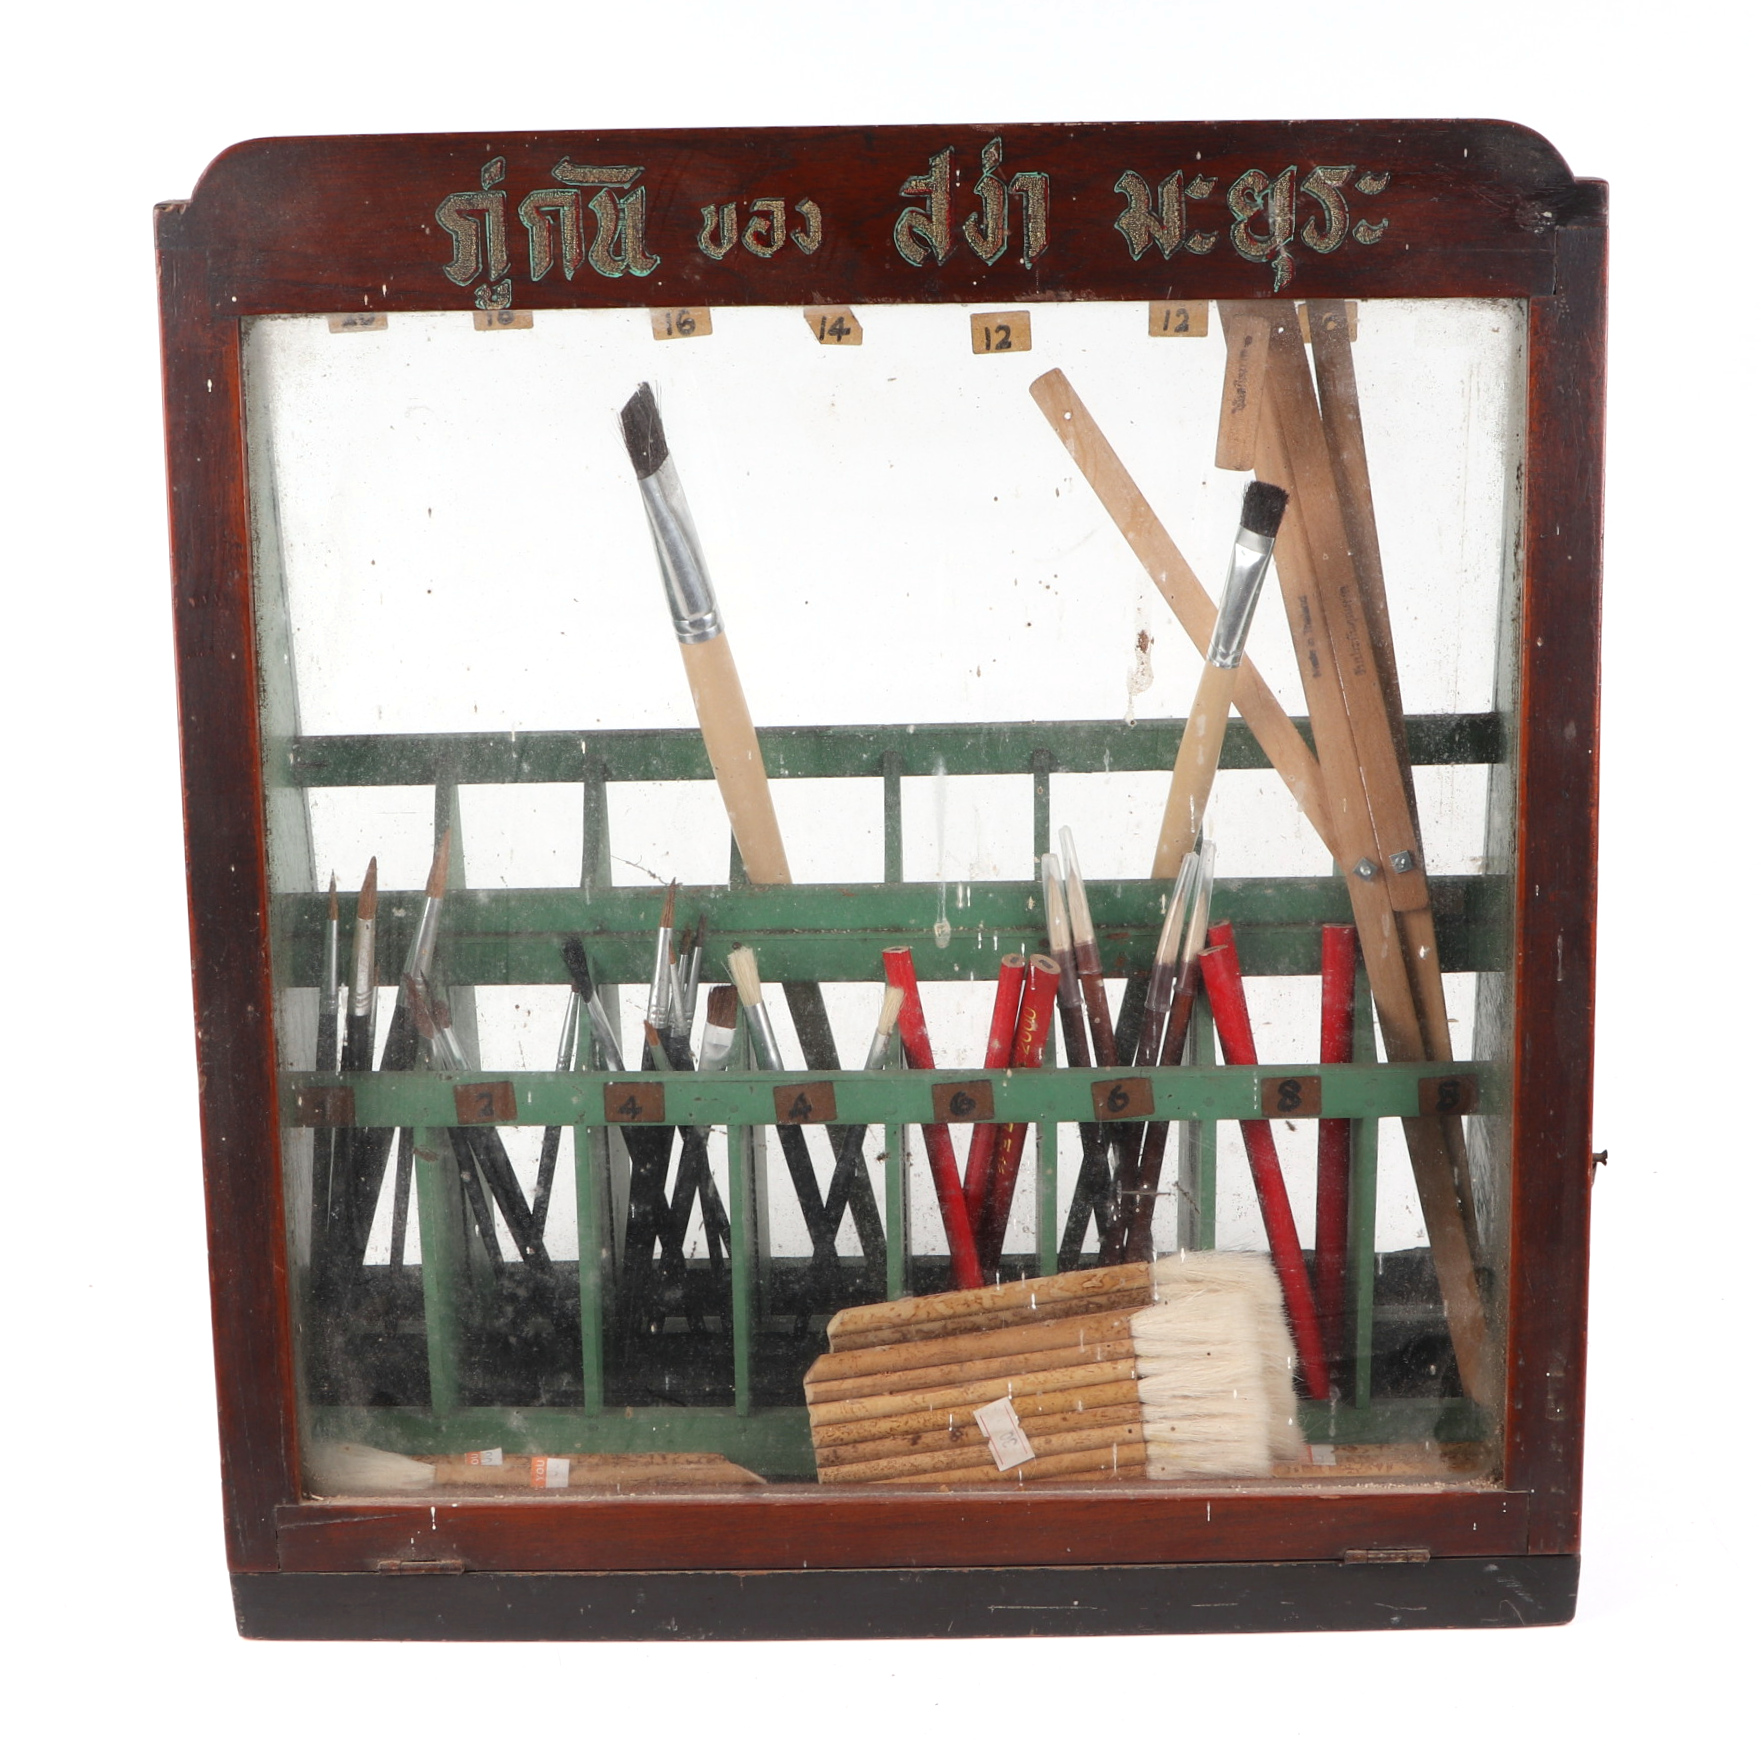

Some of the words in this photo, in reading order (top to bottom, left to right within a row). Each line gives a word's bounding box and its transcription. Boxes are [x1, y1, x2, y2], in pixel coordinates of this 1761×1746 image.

[698, 197, 823, 260] ของ
[893, 136, 1051, 270] สง่า
[665, 309, 696, 336] 16
[819, 316, 851, 342] 14
[1163, 308, 1189, 332] 12
[984, 325, 1012, 350] 12
[617, 1095, 643, 1119] 4
[950, 1091, 976, 1117] 6
[1107, 1084, 1130, 1112] 6
[1277, 1079, 1302, 1112] 8
[535, 1460, 546, 1483] YOU
